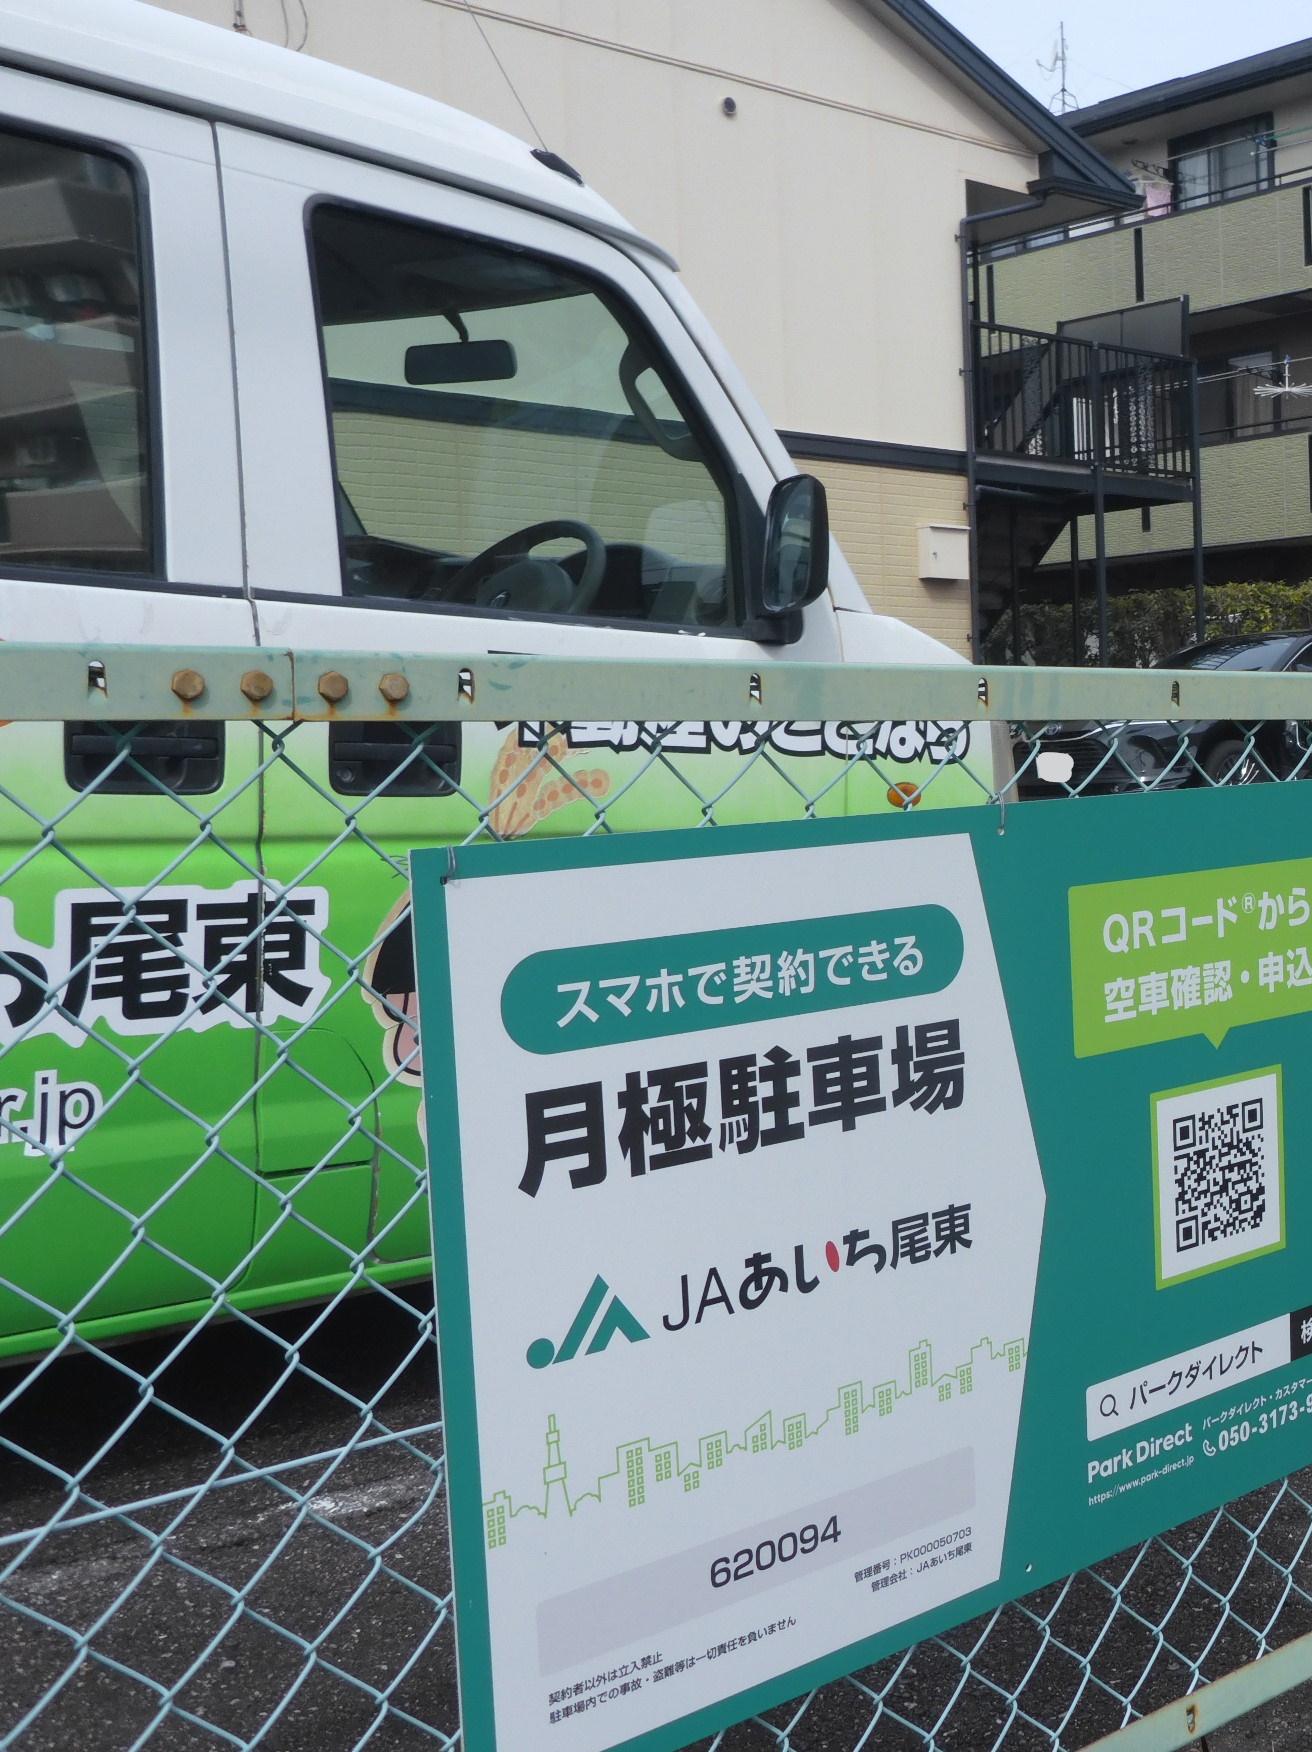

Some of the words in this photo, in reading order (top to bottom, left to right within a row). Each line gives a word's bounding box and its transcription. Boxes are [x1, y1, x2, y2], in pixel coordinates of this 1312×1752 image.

[556, 935, 925, 1029] スマホで契約できる
[518, 1018, 966, 1198] 月極駐車場
[662, 1203, 973, 1332] JAあいち尾東
[1129, 1340, 1263, 1410] パークダイレクト
[1087, 1448, 1134, 1483] Park
[1136, 1423, 1193, 1463] Direct
[1088, 1455, 1195, 1506] https://www.park-direct.jp
[710, 1515, 842, 1589] 620094
[548, 1651, 663, 1706] 契約者以外は立入禁止
[549, 1615, 797, 1724] 駐車場内での事故・盗難等は一切責任を負いません
